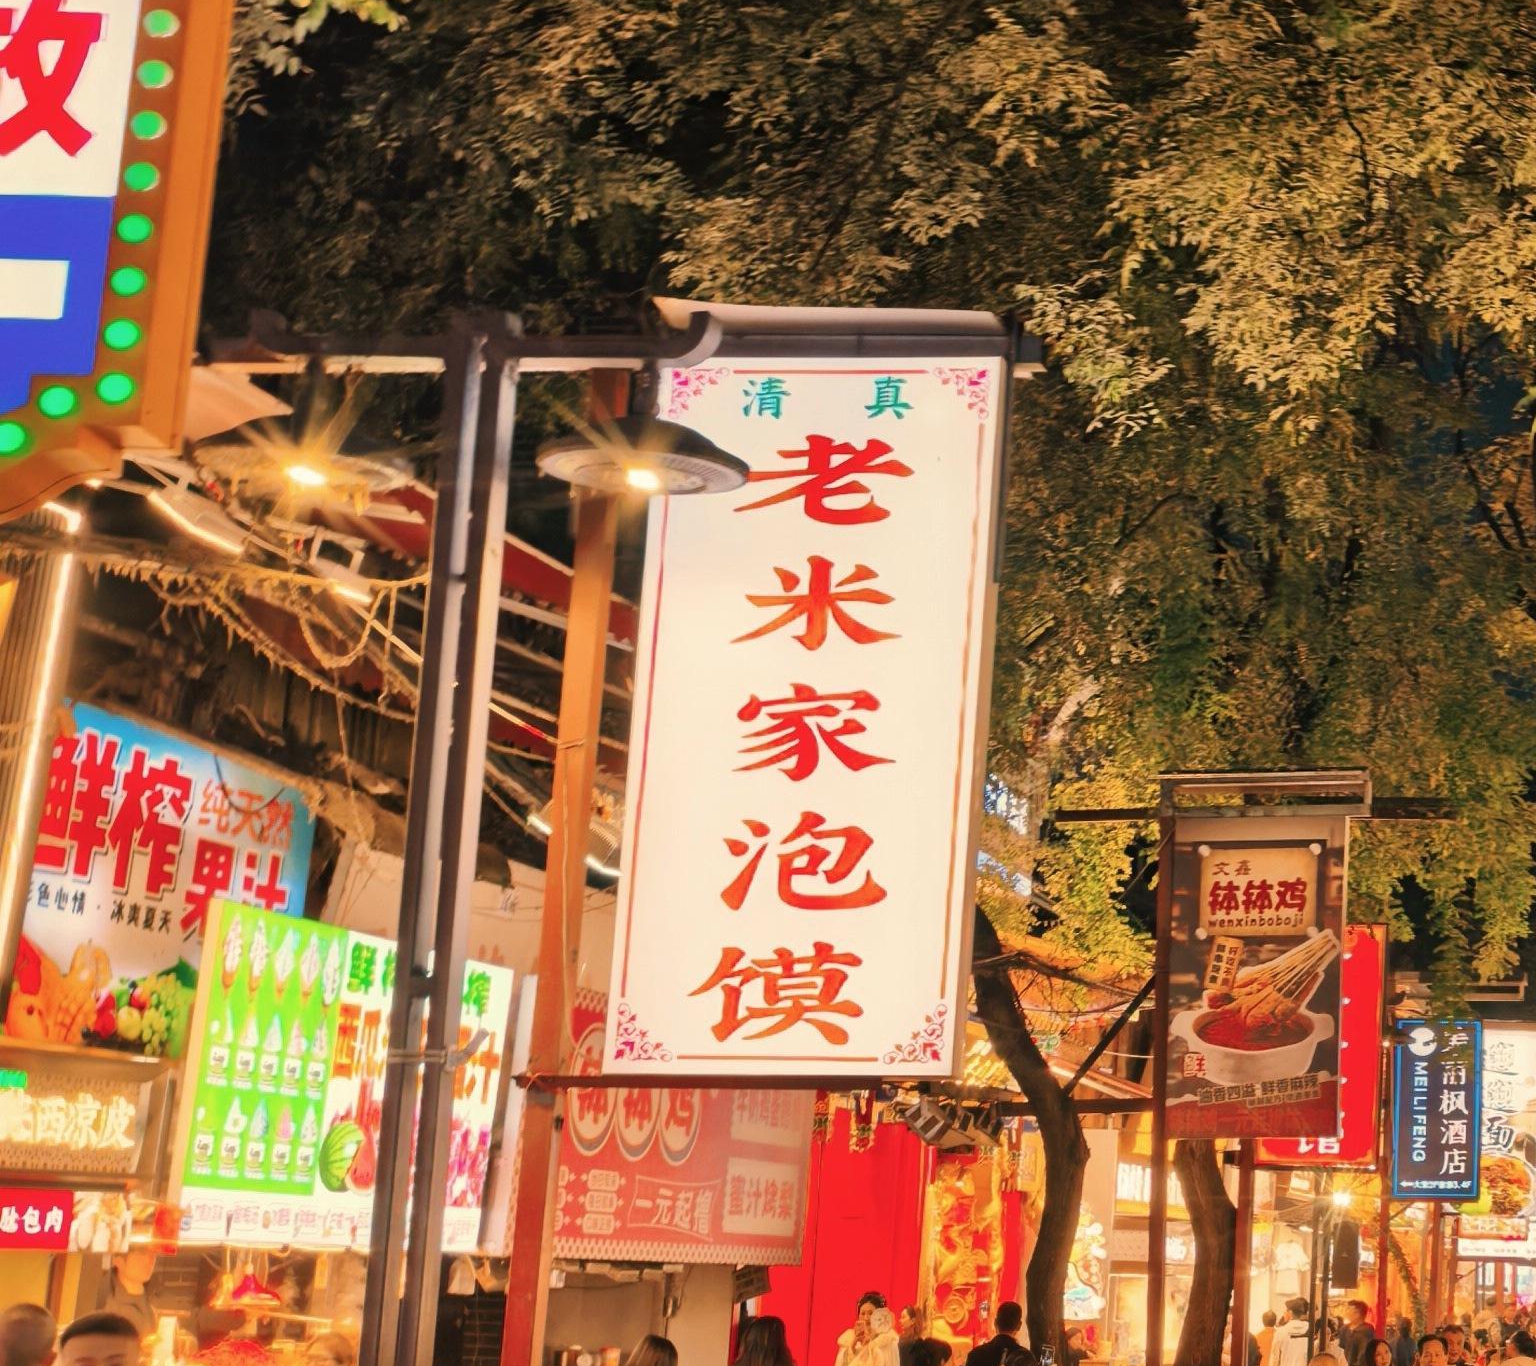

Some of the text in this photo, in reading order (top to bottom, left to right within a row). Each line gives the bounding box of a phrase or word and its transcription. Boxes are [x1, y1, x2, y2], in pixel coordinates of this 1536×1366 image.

[742, 377, 915, 421] 清真
[688, 433, 915, 1046] 老米家泡馍
[34, 730, 193, 901] 鲜榨
[199, 778, 294, 850] 纯天然
[1208, 877, 1307, 915] 钵钵鸡
[1208, 914, 1304, 928] wenxinboboji
[333, 1002, 388, 1079] 西瓜
